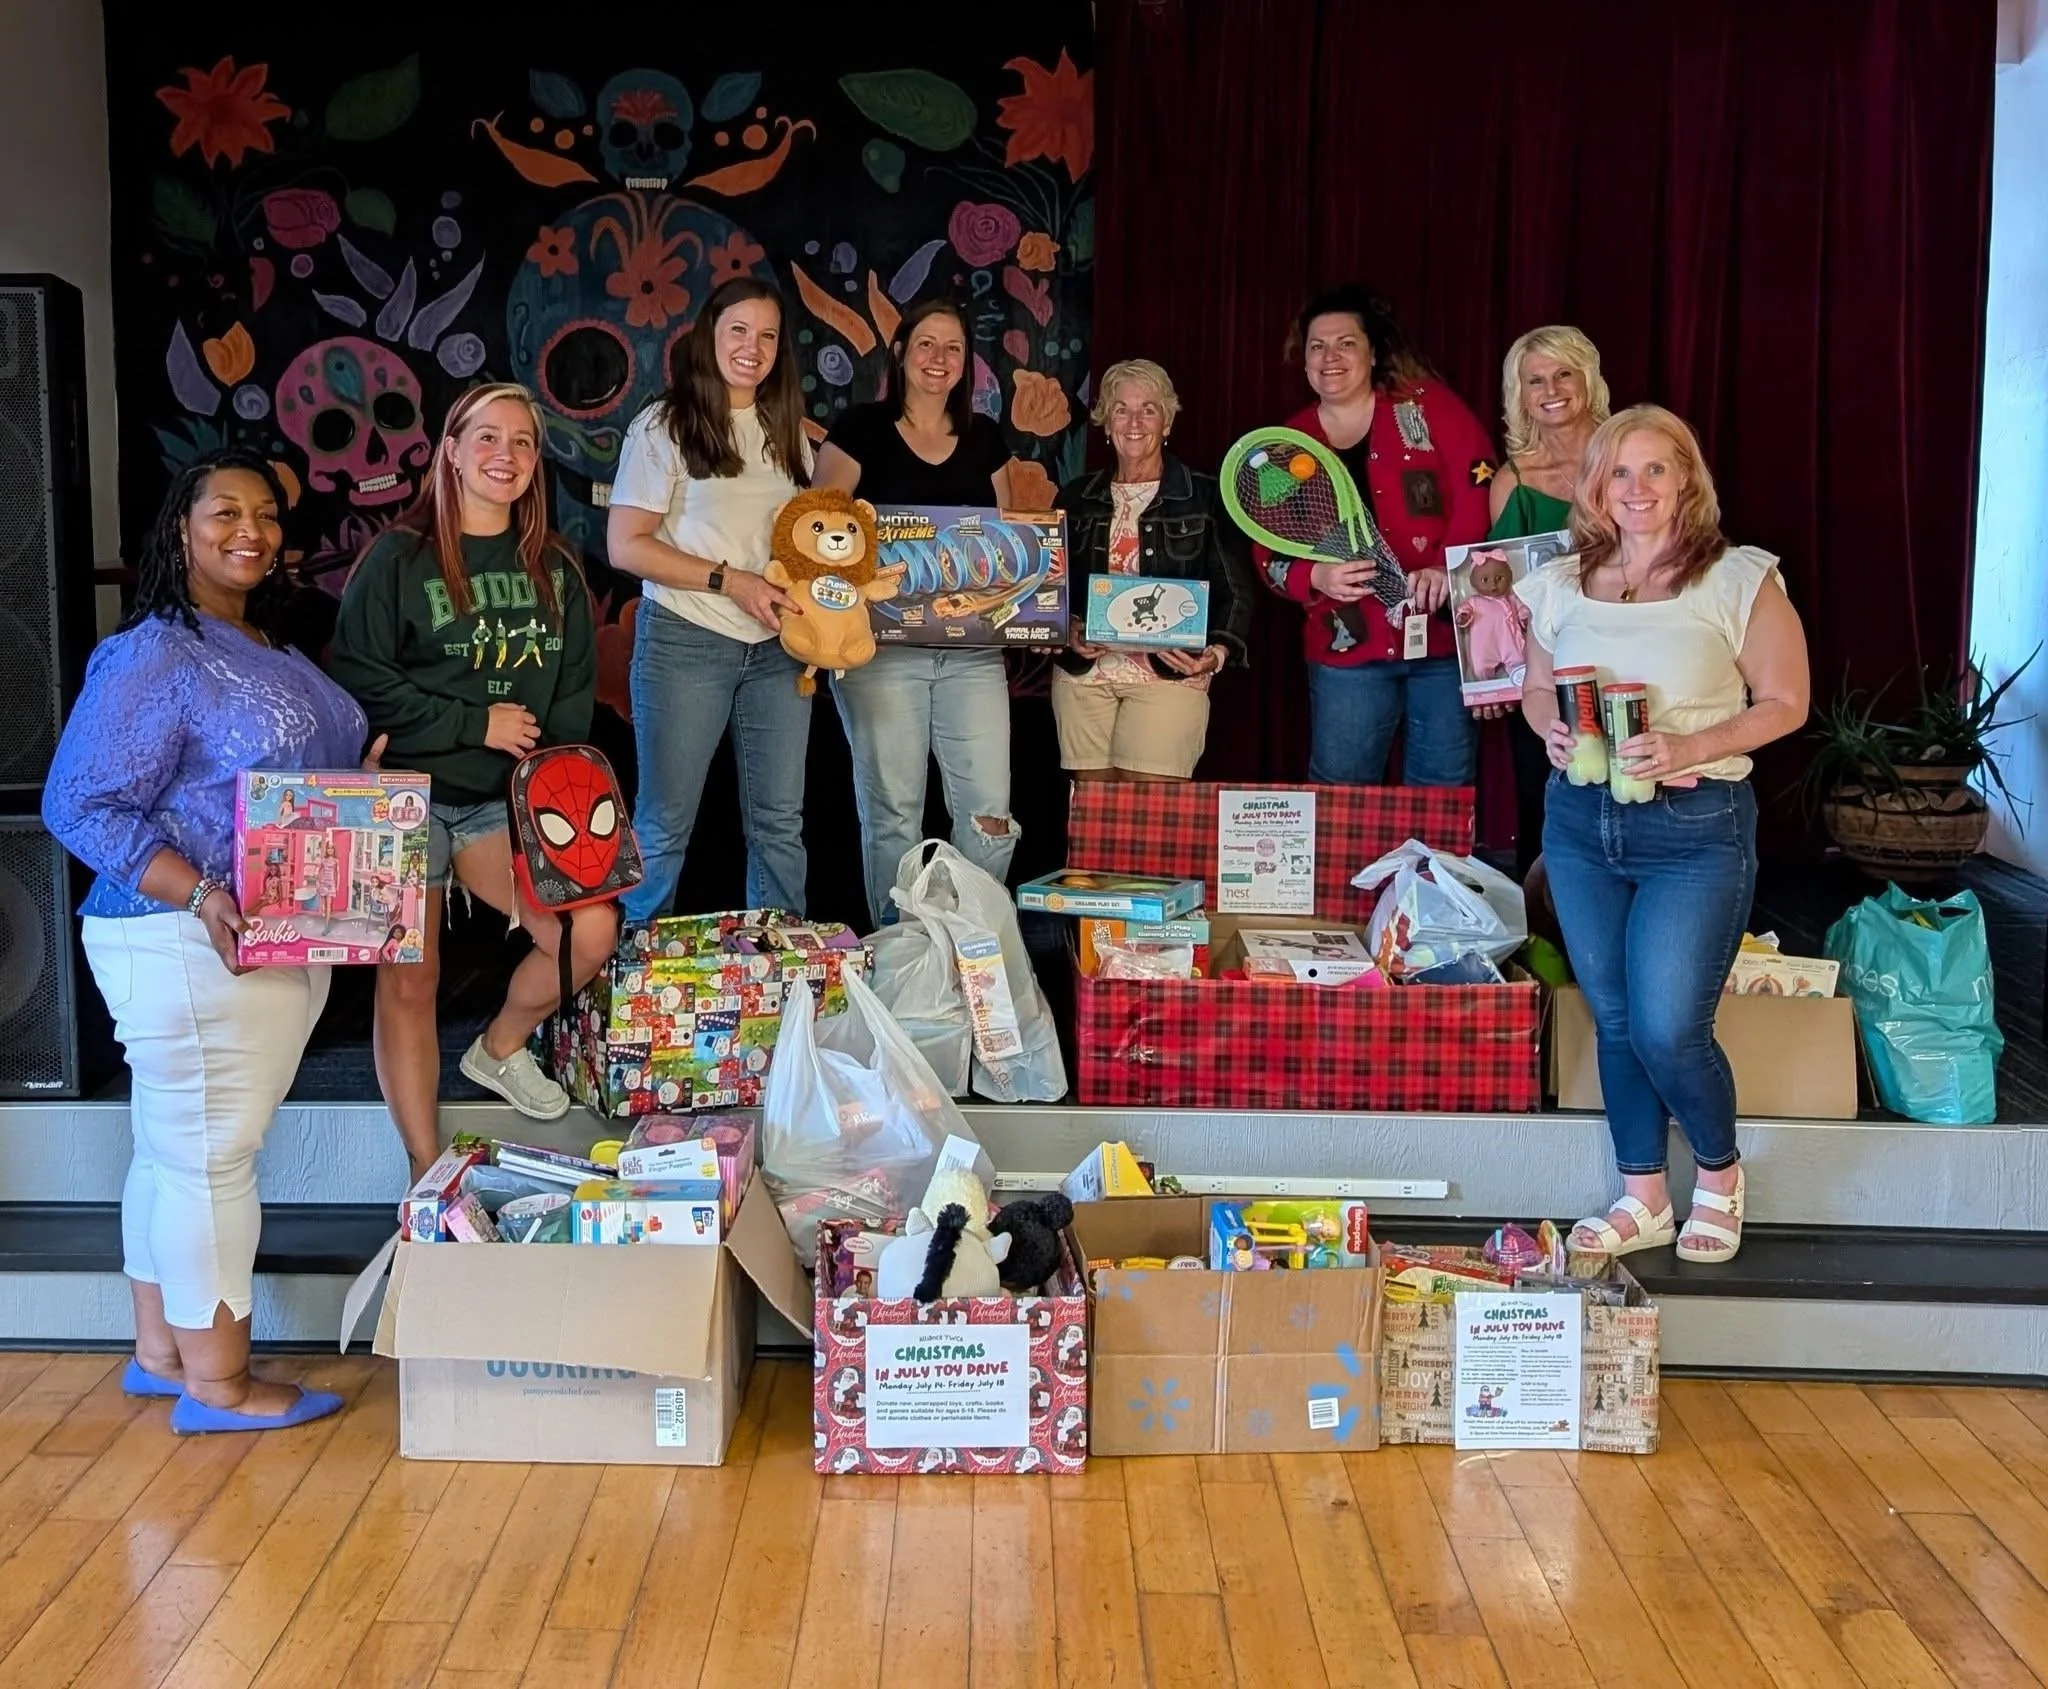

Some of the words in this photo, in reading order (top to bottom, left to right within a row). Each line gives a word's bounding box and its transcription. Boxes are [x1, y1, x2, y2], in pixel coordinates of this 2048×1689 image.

[880, 515, 929, 527] MOTOR
[877, 525, 937, 543] EXTREME
[444, 642, 470, 658] EST
[545, 636, 563, 652] 20
[488, 680, 513, 696] ELF
[1243, 800, 1289, 810] CHRISTMAS
[1241, 812, 1261, 820] JULY
[1279, 810, 1302, 818] DRIVE
[1226, 888, 1250, 898] nest
[244, 918, 302, 947] Barbie
[713, 997, 741, 1011] NOEL
[709, 1090, 737, 1106] NOEL
[622, 1157, 642, 1169] ERIC
[668, 1161, 693, 1170] Puppets
[623, 1166, 644, 1176] CARLE
[1353, 1208, 1364, 1252] fisher-price
[1382, 1312, 1417, 1321] ERRY
[1431, 1306, 1439, 1330] LVES
[1484, 1308, 1548, 1320] CHRISTMAS
[1470, 1325, 1480, 1335] IN
[1484, 1324, 1509, 1333] JULY
[1512, 1323, 1533, 1332] TOY
[1535, 1321, 1565, 1331] DRIVE
[1606, 1328, 1624, 1337] AND
[1628, 1328, 1659, 1338] BRIGH
[1472, 1334, 1497, 1342] Monday
[1499, 1333, 1511, 1341] July
[1522, 1333, 1541, 1341] Friday
[1542, 1332, 1554, 1341] July
[895, 1343, 985, 1362] CHRISTMAS
[875, 1368, 890, 1381] IN
[894, 1365, 930, 1379] JULY
[934, 1363, 963, 1377] TOY
[966, 1361, 1009, 1376] DRIVE
[1388, 1349, 1400, 1388] MISTLETOE
[1400, 1371, 1433, 1388] JOY
[1597, 1373, 1633, 1384] HOLLY
[1633, 1355, 1645, 1397] MISTLETOE
[879, 1382, 912, 1391] Monday
[915, 1381, 932, 1390] July
[948, 1380, 975, 1390] Friday
[977, 1379, 994, 1388] July
[996, 1379, 1005, 1387] 18
[1385, 1390, 1429, 1399] MERRY
[1444, 1381, 1452, 1410] ELVES
[1606, 1383, 1615, 1414] ELVES
[675, 1390, 685, 1424] 40902
[1395, 1401, 1428, 1410] BRIGHT
[941, 1414, 973, 1422] perishable
[1617, 1408, 1637, 1417] AND
